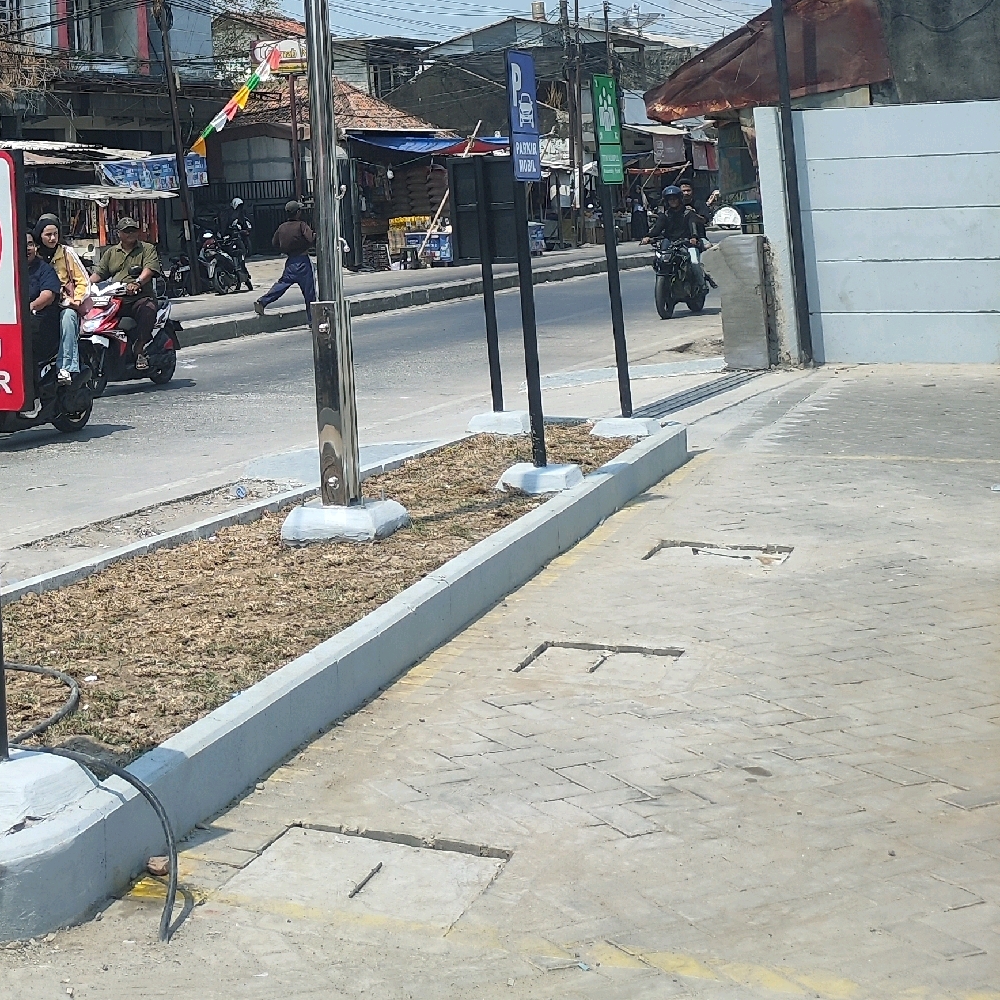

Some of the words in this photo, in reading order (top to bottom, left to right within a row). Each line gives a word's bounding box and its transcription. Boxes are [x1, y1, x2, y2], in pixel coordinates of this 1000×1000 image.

[511, 63, 521, 107] P
[515, 141, 538, 155] PARKIR
[519, 159, 537, 173] MOBIL
